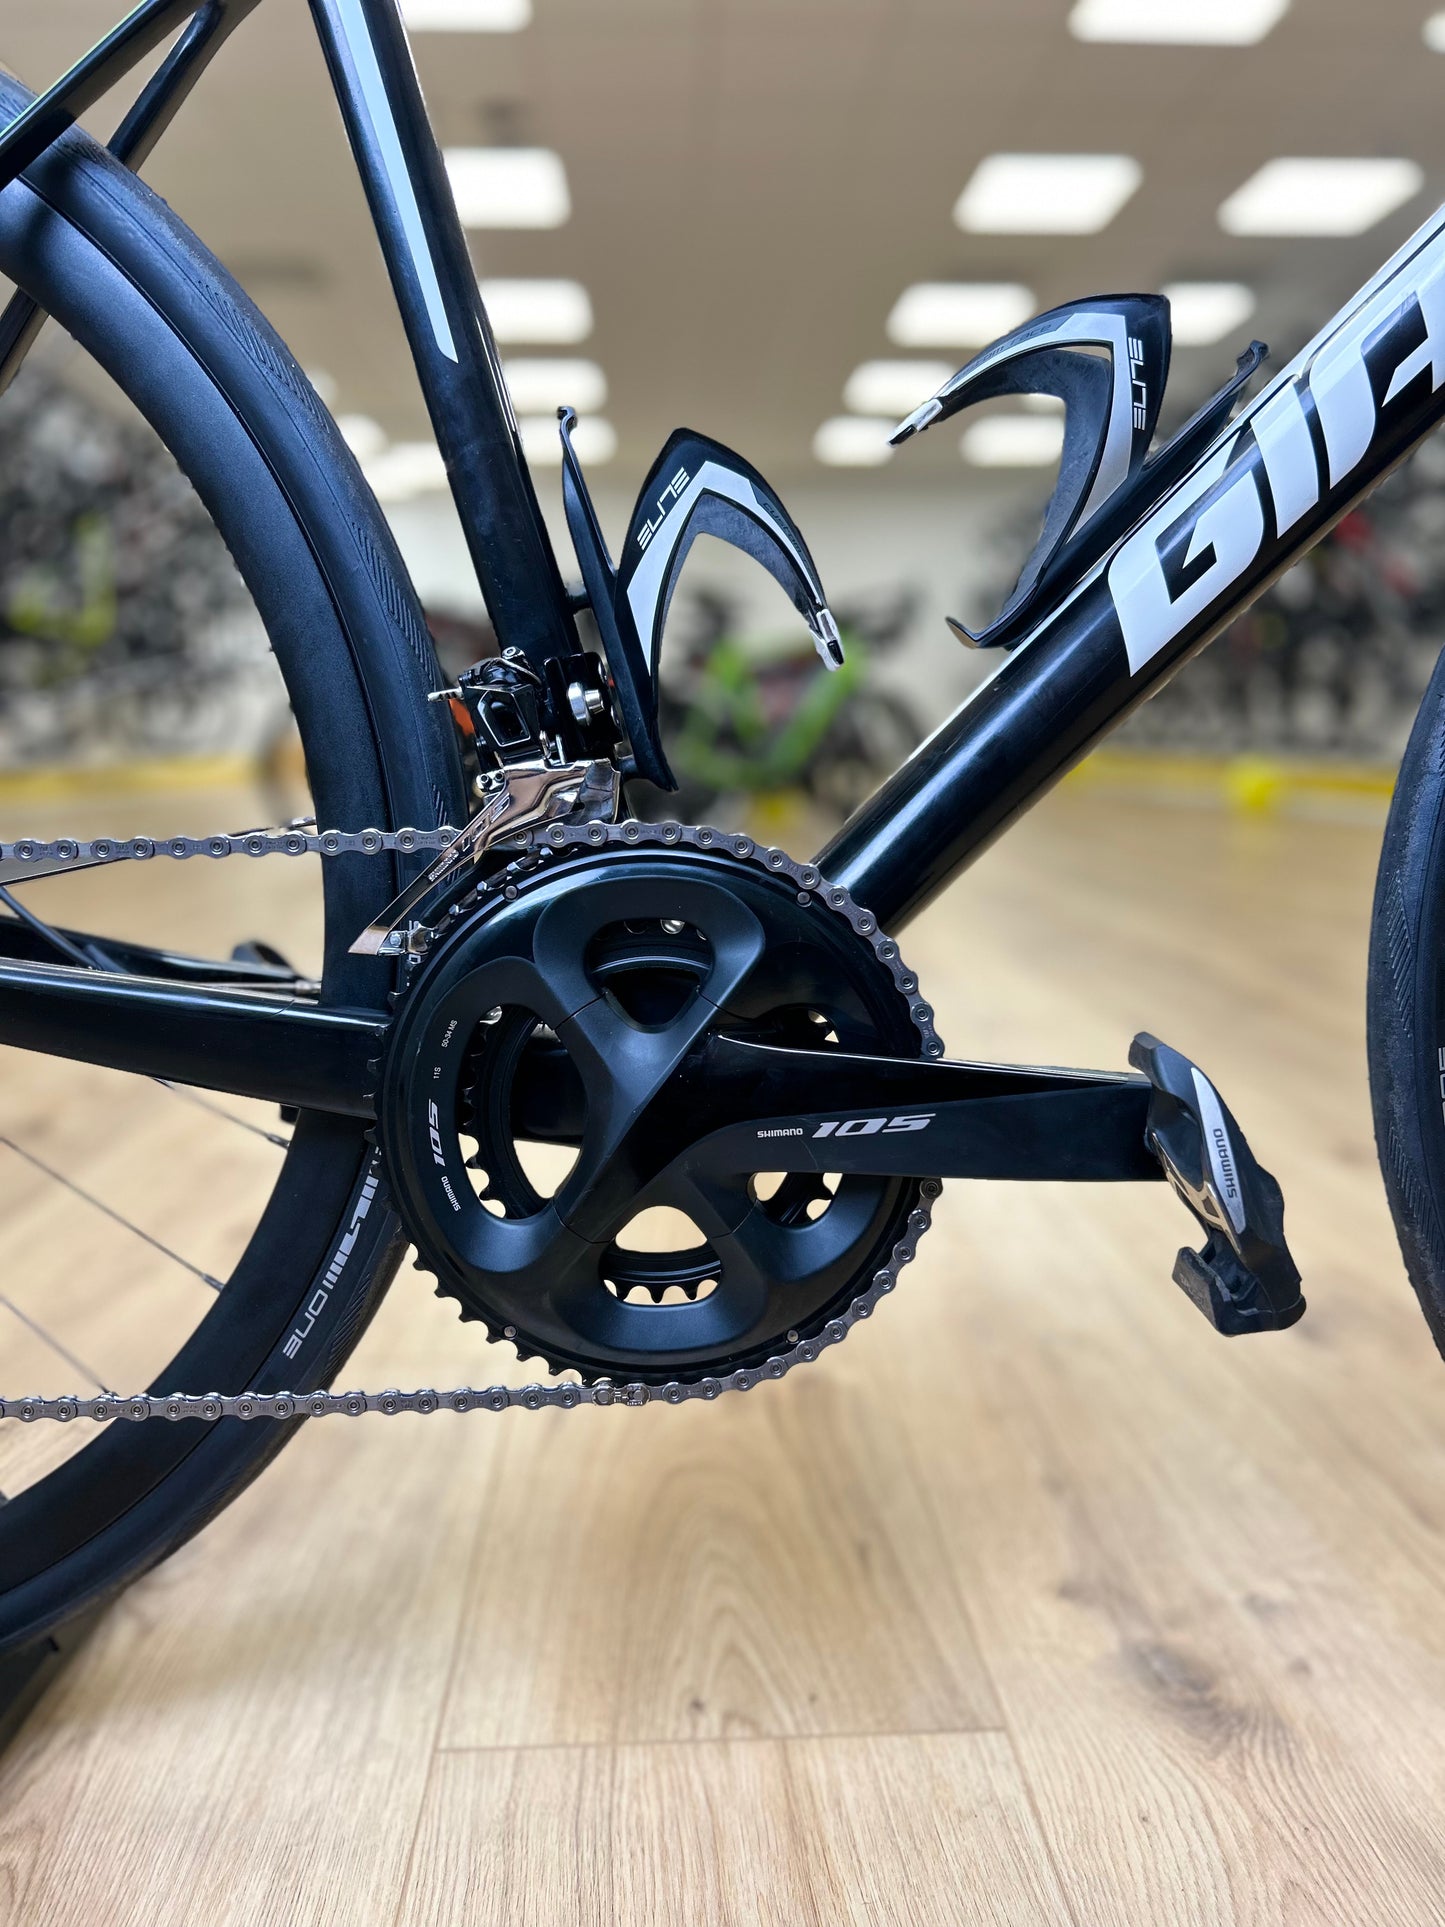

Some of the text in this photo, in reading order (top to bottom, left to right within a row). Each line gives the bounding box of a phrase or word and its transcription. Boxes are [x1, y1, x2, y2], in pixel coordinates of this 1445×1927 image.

[1127, 337, 1147, 431] ELITE
[636, 467, 690, 551] ELITE
[433, 1066, 441, 1079] 11S
[428, 1098, 446, 1167] 105
[757, 1113, 936, 1138] SHIMANO 105
[441, 1175, 462, 1212] SHIMANO
[1213, 1128, 1238, 1199] SHIMANO
[282, 1289, 329, 1359] ONE
